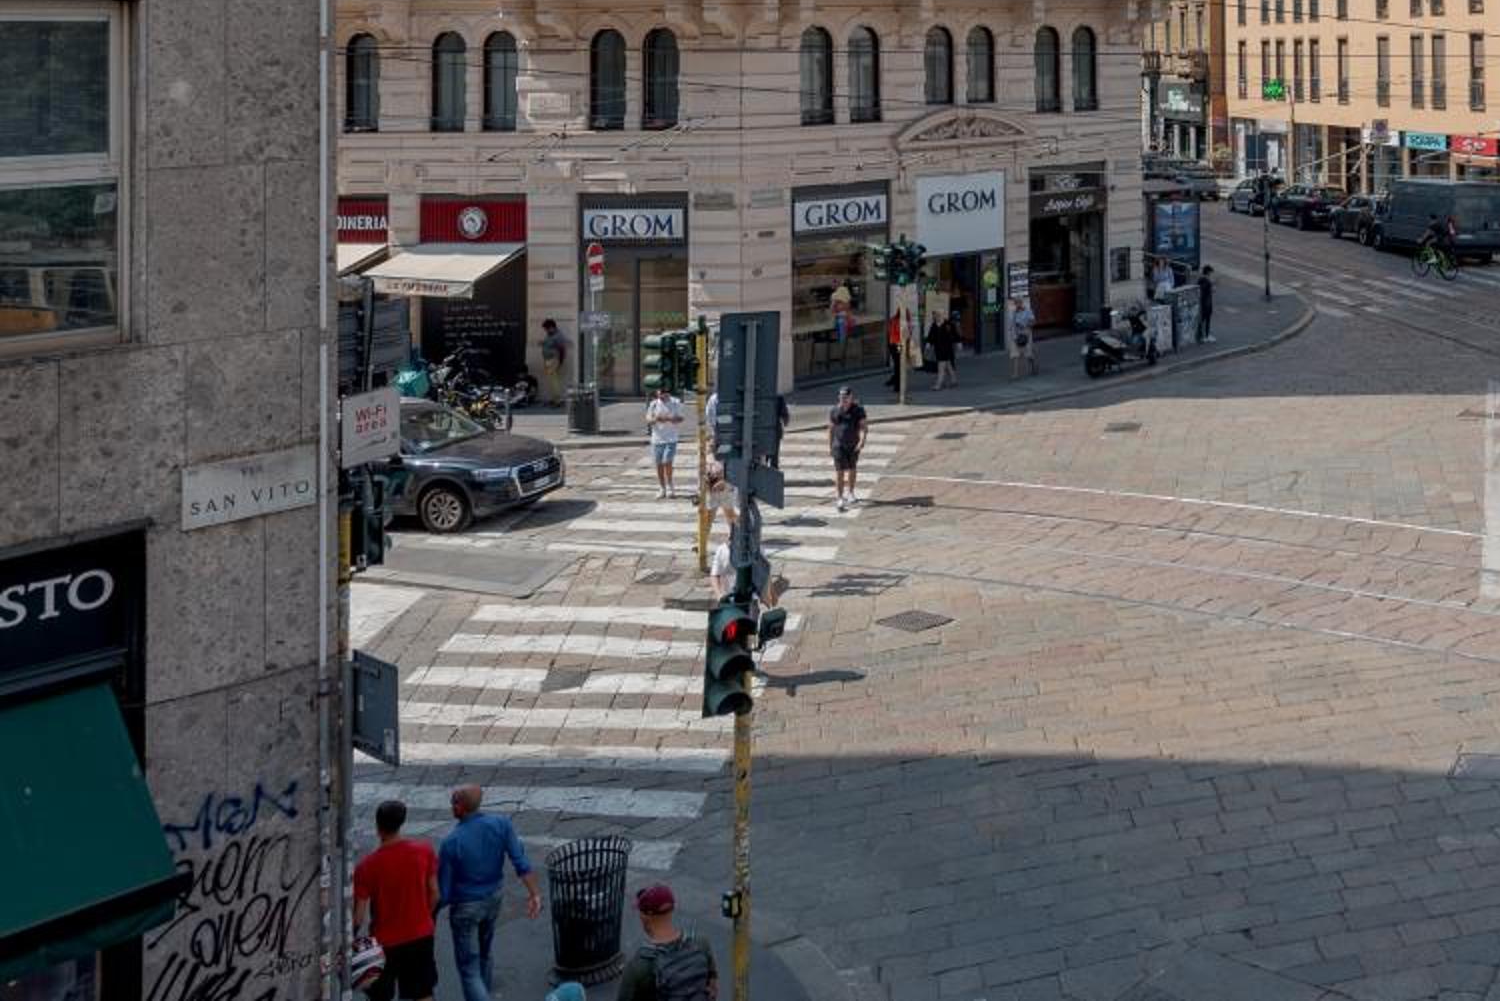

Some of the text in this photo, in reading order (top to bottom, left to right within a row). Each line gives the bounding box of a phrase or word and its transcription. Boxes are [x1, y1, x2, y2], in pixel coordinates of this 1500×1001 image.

[805, 199, 882, 228] GROM
[928, 187, 996, 215] GROM
[589, 214, 674, 237] GROM
[191, 480, 309, 516] SAN VITO
[0, 569, 115, 629] STO
